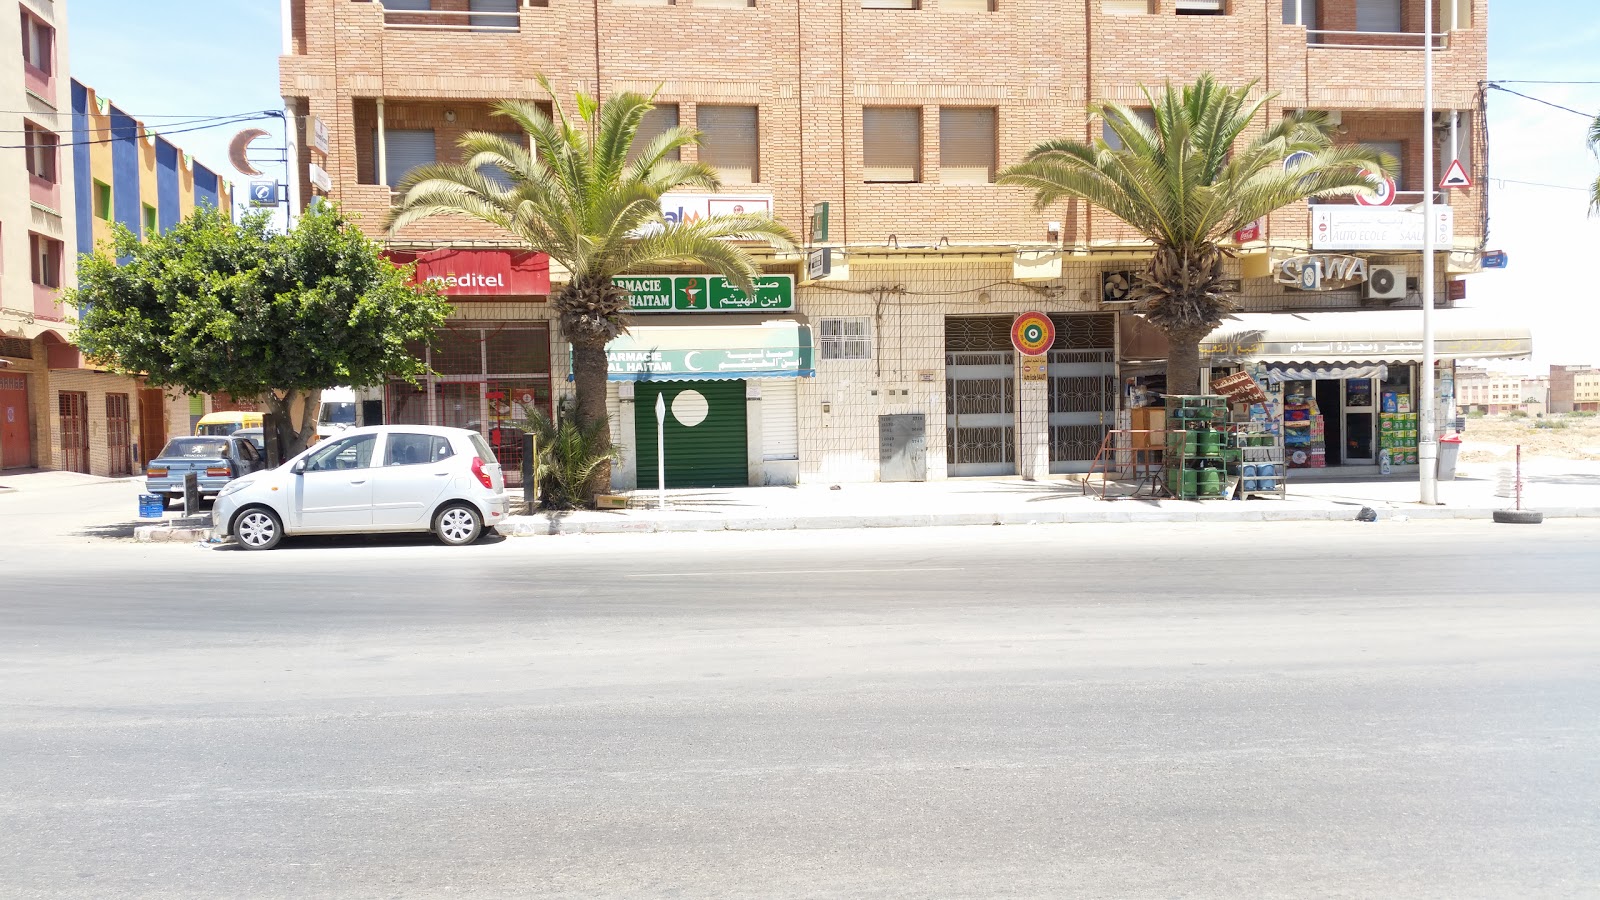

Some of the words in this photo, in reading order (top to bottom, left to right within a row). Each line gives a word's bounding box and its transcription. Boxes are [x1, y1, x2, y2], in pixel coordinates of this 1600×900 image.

[1332, 230, 1357, 241] AUTO
[1359, 230, 1388, 241] ECOLE
[1400, 231, 1425, 241] SAAL
[611, 280, 661, 292] ARMACIE
[721, 278, 780, 292] صيية
[628, 295, 670, 307] HAITAM
[719, 294, 758, 308] الهيثم
[760, 294, 782, 307] ابن
[607, 352, 662, 362] ARMACIE
[626, 362, 672, 372] HAITAM
